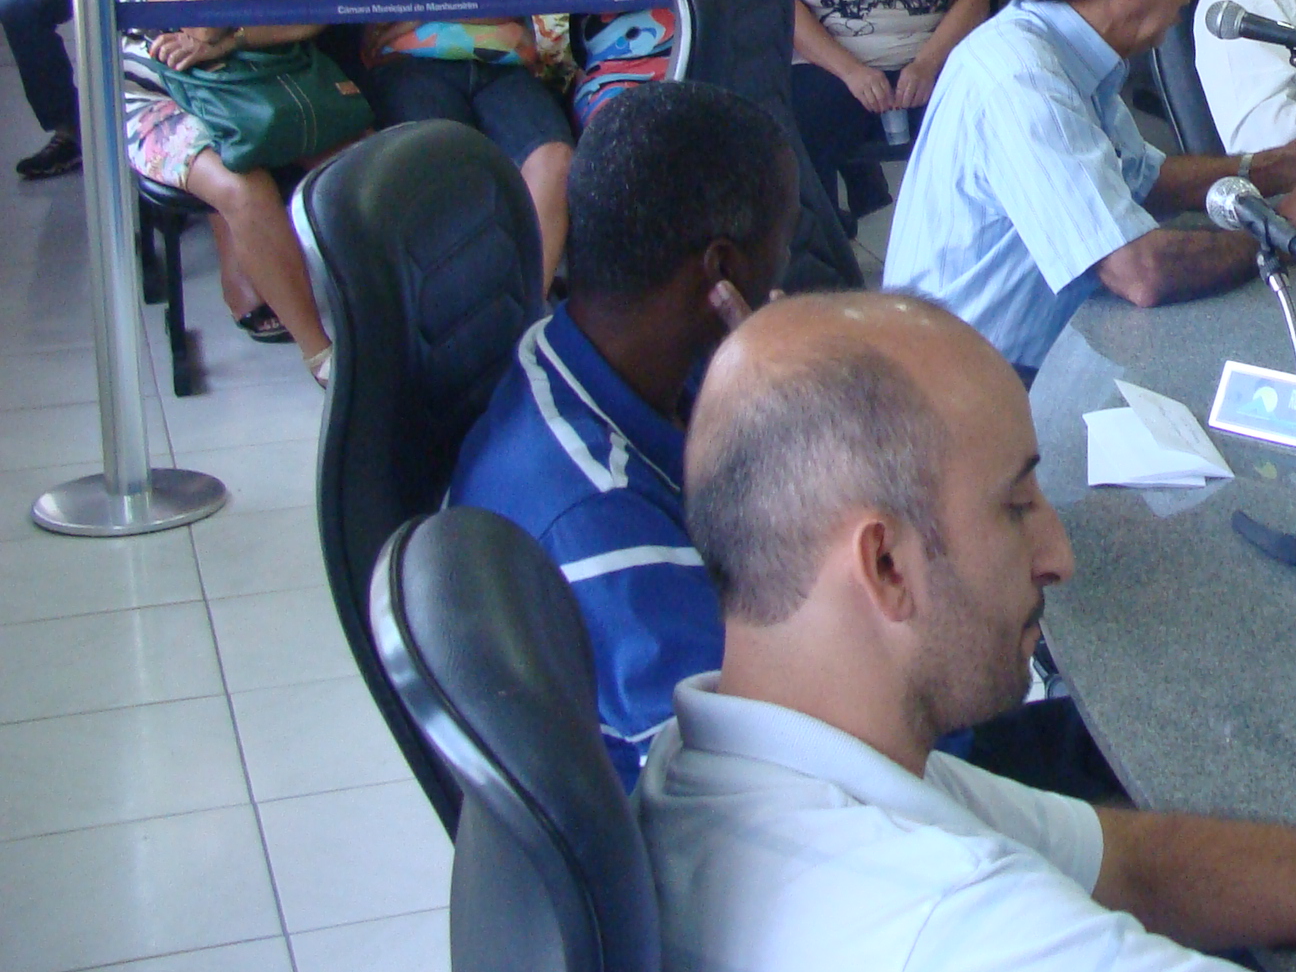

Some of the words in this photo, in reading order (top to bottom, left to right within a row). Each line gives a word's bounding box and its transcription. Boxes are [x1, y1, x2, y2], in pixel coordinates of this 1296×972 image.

[337, 5, 370, 15] Câmara
[372, 2, 413, 14] Municipal
[414, 3, 425, 12] de
[426, 1, 479, 11] Manhumirim
